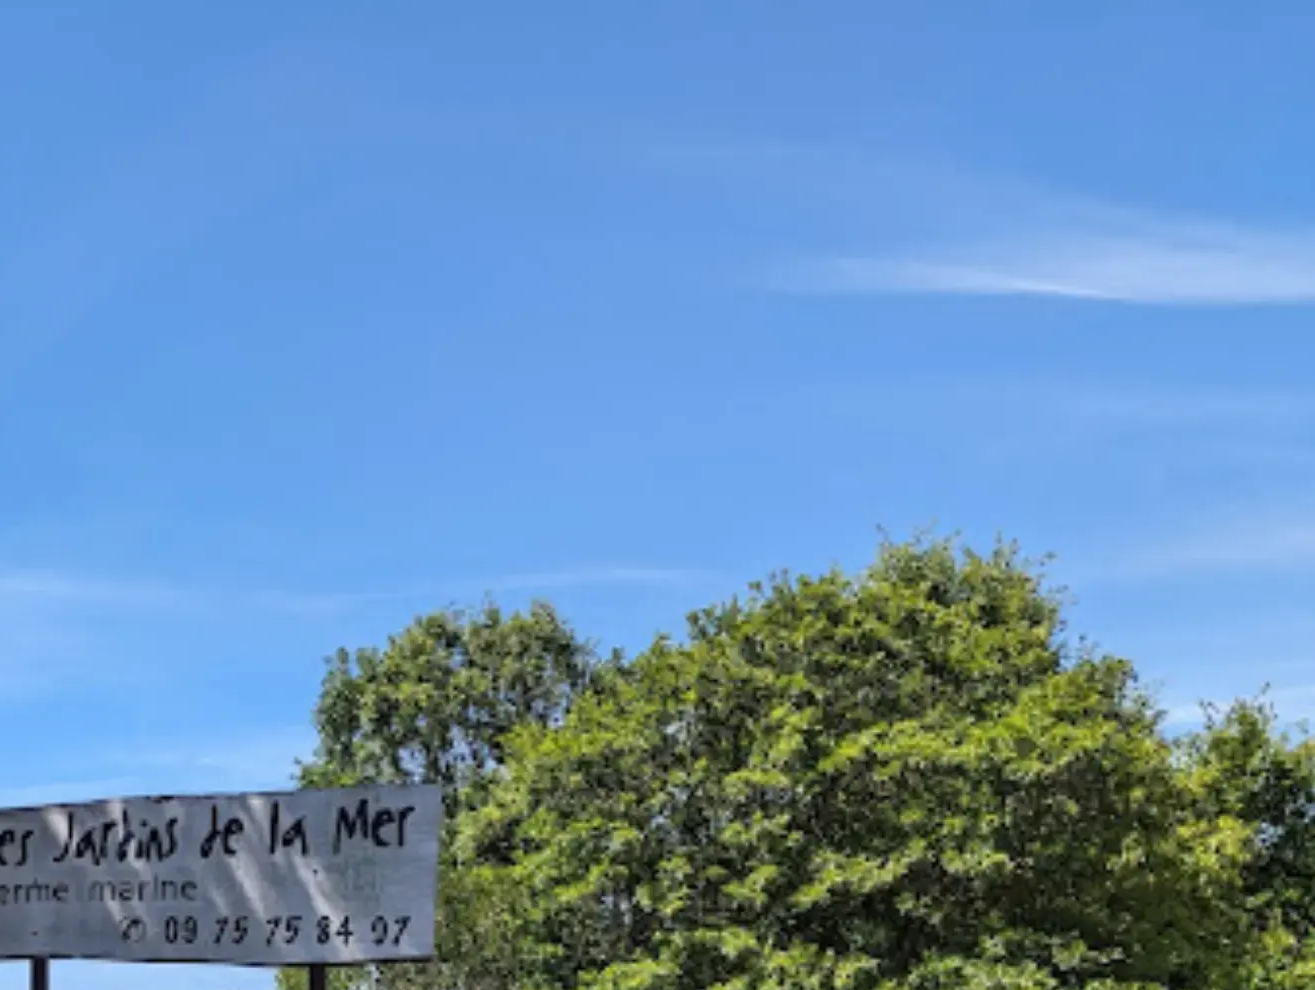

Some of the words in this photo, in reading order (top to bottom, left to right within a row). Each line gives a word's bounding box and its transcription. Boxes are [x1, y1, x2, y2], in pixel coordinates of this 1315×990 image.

[53, 809, 178, 866] Jardins
[200, 804, 244, 858] de
[270, 801, 308, 856] la
[334, 798, 415, 853] Mer
[89, 874, 198, 900] marine
[164, 915, 199, 944] 09
[213, 916, 249, 946] 75
[266, 915, 303, 947] 75
[316, 915, 354, 947] 84
